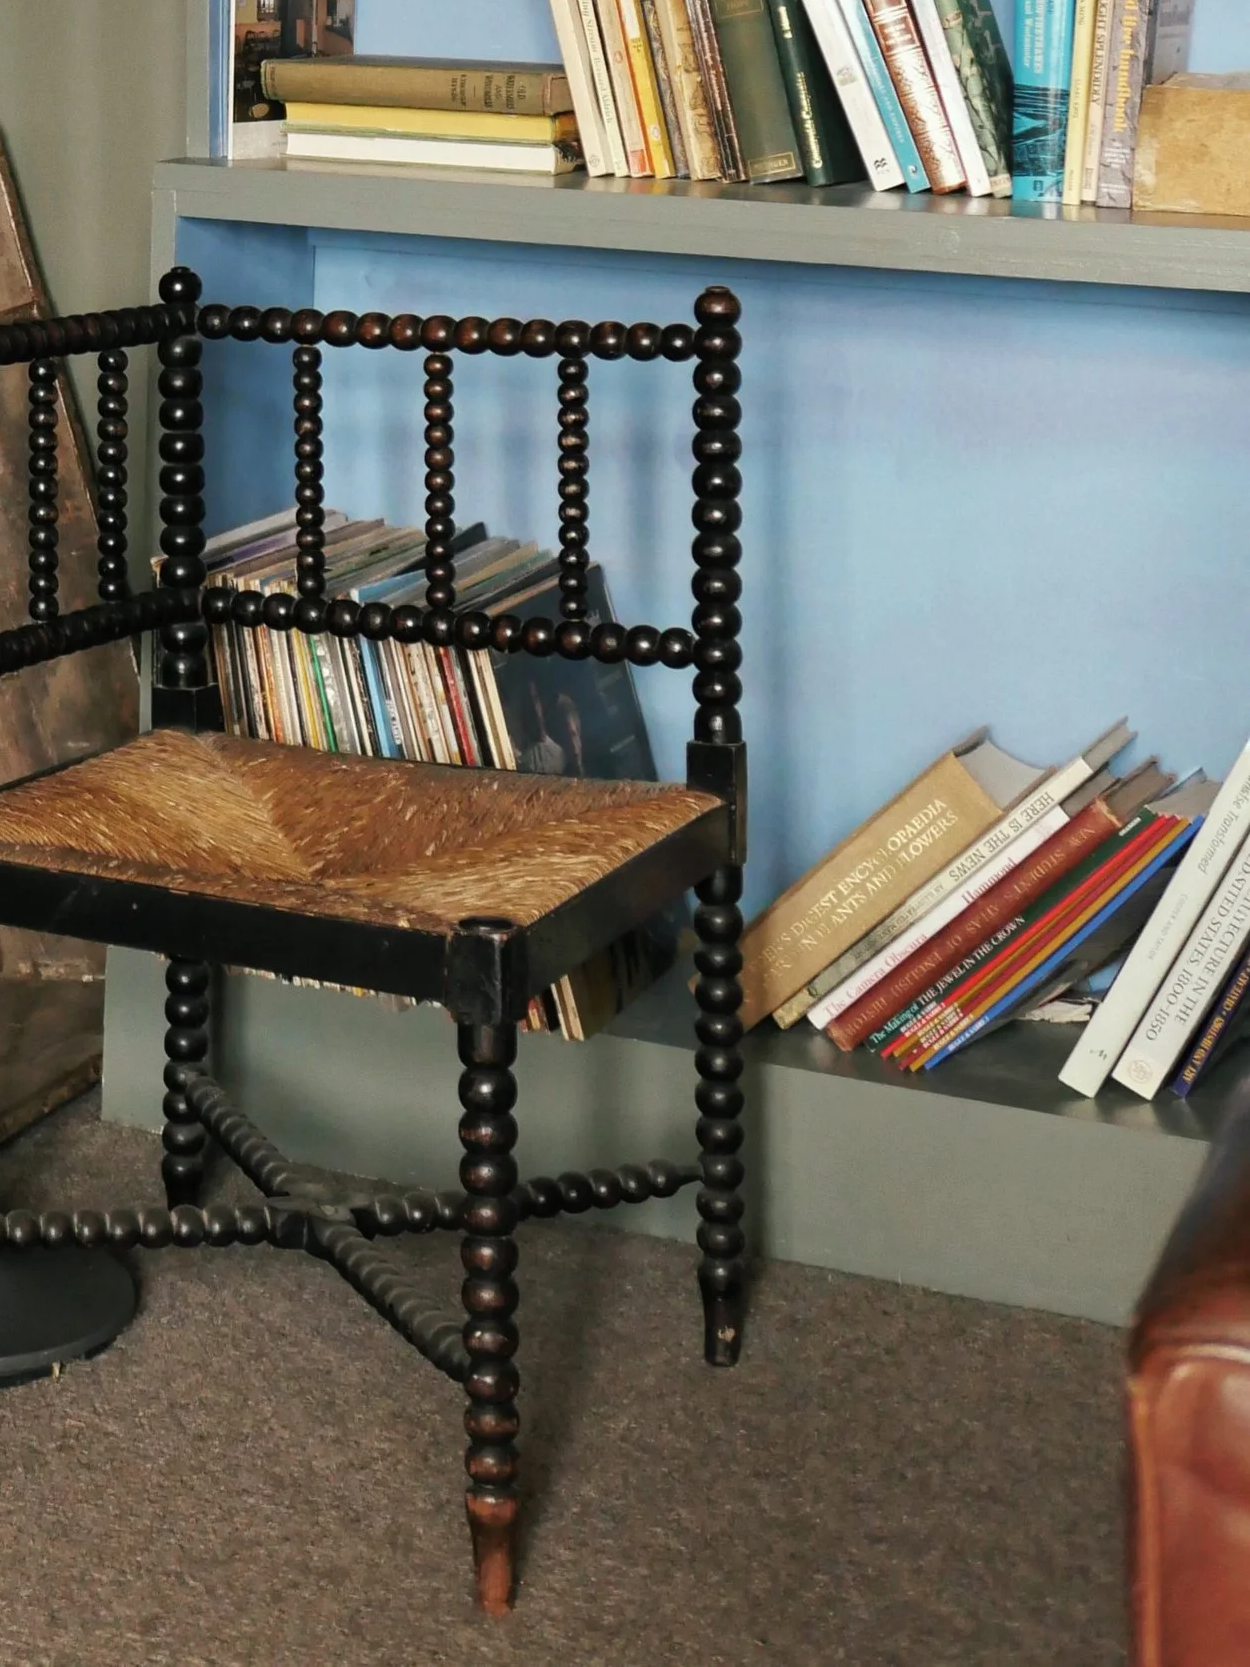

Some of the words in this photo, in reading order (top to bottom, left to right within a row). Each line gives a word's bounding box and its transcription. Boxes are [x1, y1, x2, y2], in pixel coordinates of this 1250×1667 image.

[1088, 33, 1106, 106] SPLENDIDLY
[1111, 47, 1136, 133] handbook
[1006, 817, 1023, 834] IS
[1019, 790, 1055, 823] HERE
[982, 827, 1011, 853] THE
[1066, 822, 1095, 849] NEW
[1195, 809, 1239, 875] Transformed
[947, 847, 986, 882] NEWS
[790, 889, 842, 938] DIGEST
[963, 900, 1002, 935] ATLAS
[822, 994, 848, 1018] The
[844, 965, 886, 1001] Camera
[881, 928, 928, 969] Obscura
[959, 854, 1018, 905] Hammond
[943, 934, 964, 954] OF
[869, 1027, 887, 1045] The
[882, 1006, 914, 1036] Making
[907, 999, 921, 1013] of
[916, 984, 940, 1007] THE
[932, 961, 968, 994] JEWEL
[960, 953, 977, 969] IN
[970, 939, 995, 961] THE
[988, 912, 1027, 947] CROWN
[888, 950, 943, 999] ENGLISH
[1189, 975, 1210, 997] IN
[1142, 963, 1194, 1045] 1800-1850
[1172, 993, 1200, 1028] THE
[1180, 1064, 1196, 1083] ART
[1189, 1045, 1207, 1066] AND
[1198, 1014, 1225, 1050] HISTORY
